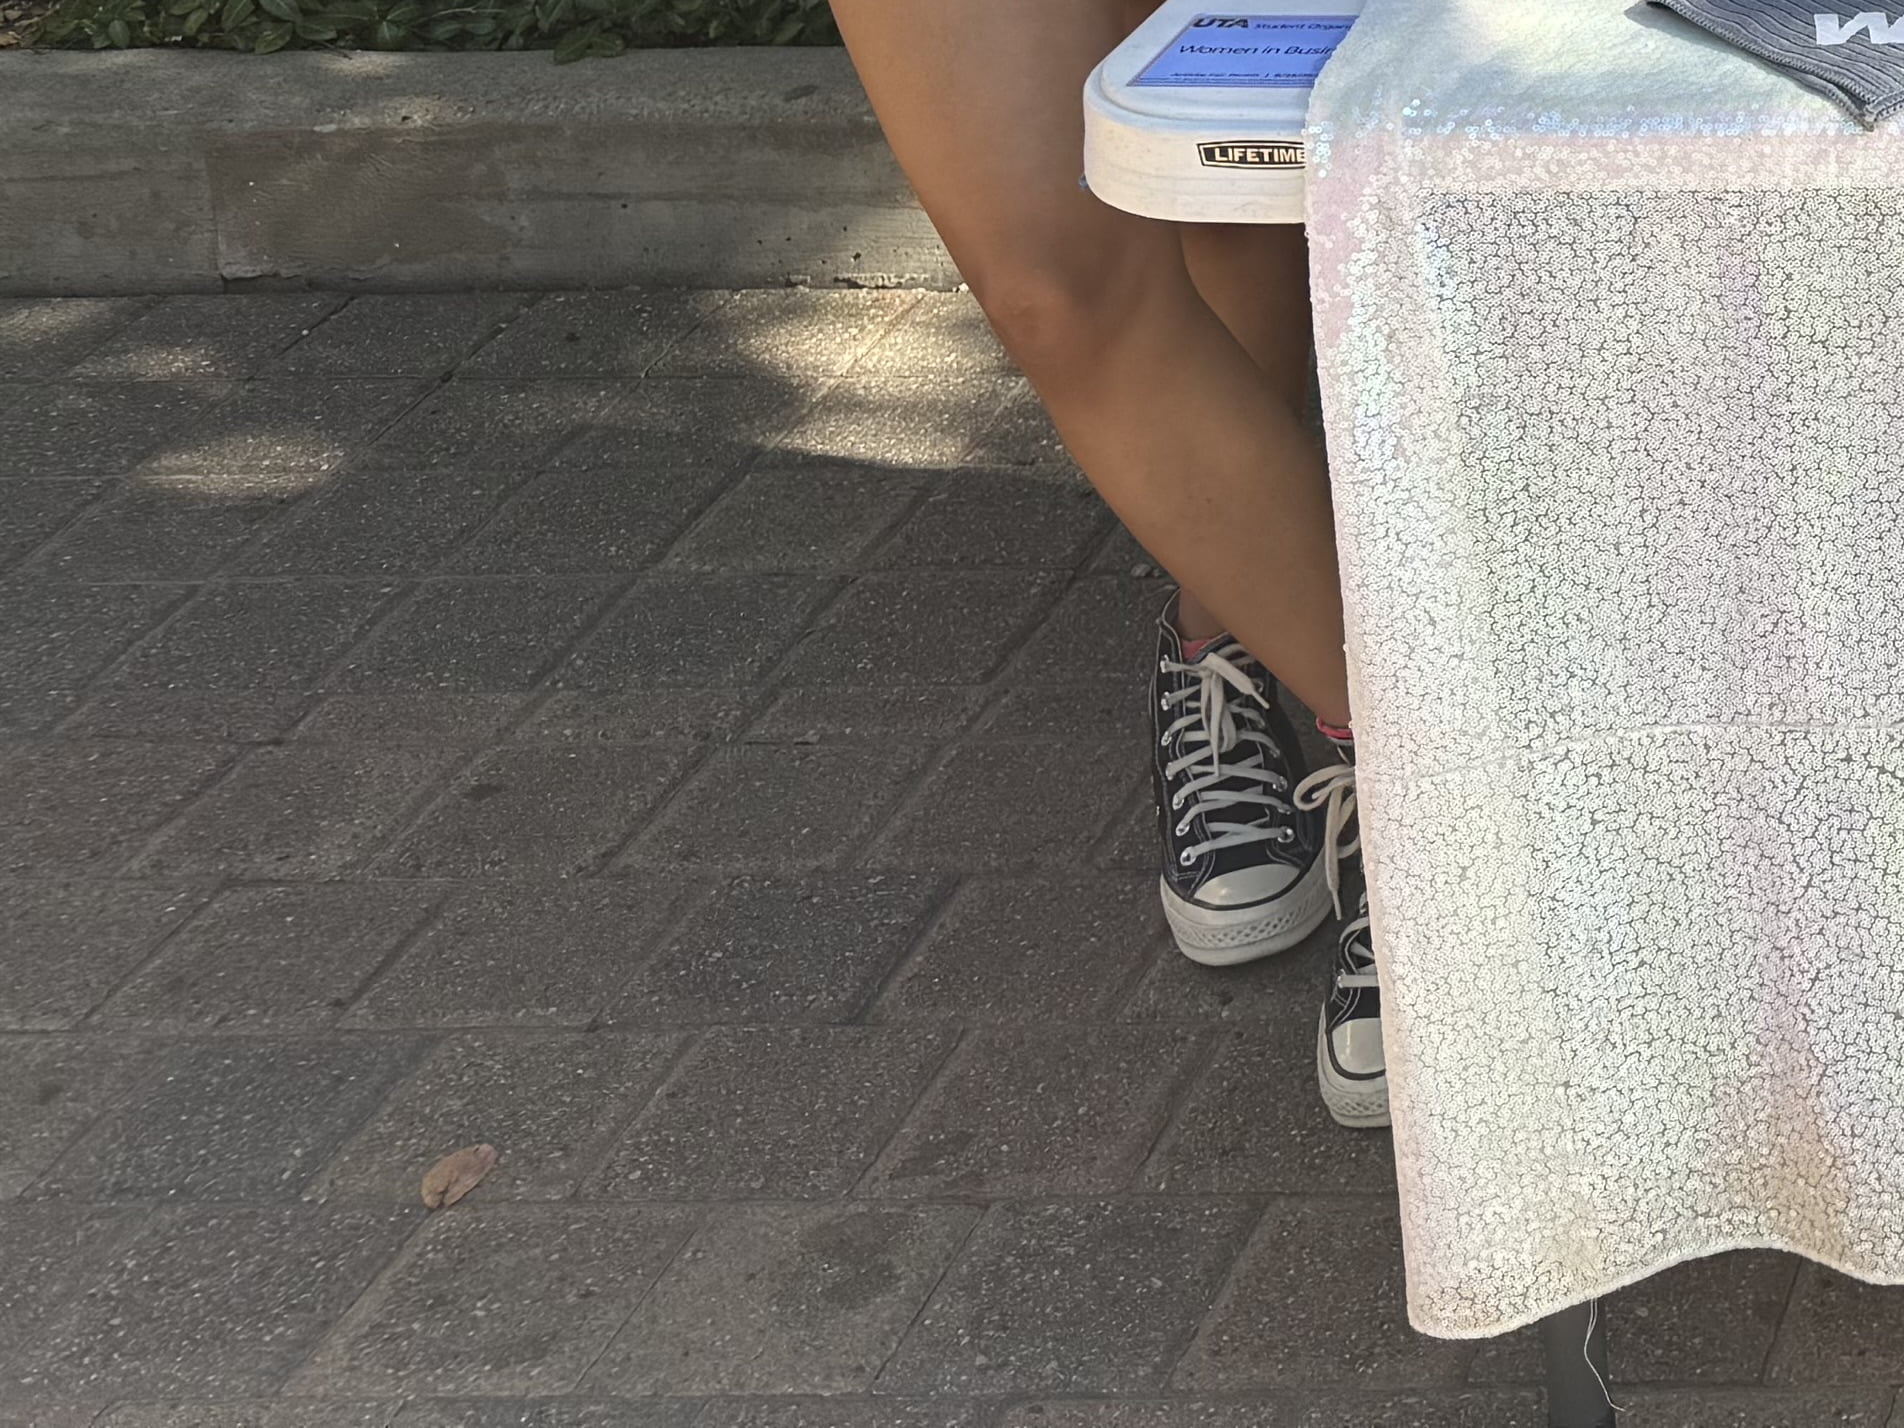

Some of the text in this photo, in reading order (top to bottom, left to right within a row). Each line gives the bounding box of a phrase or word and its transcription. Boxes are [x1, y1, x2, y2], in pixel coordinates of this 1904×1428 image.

[1192, 17, 1250, 29] UTA
[1179, 45, 1258, 55] Women
[1262, 45, 1281, 55] in
[1214, 147, 1305, 164] LIFETIME
